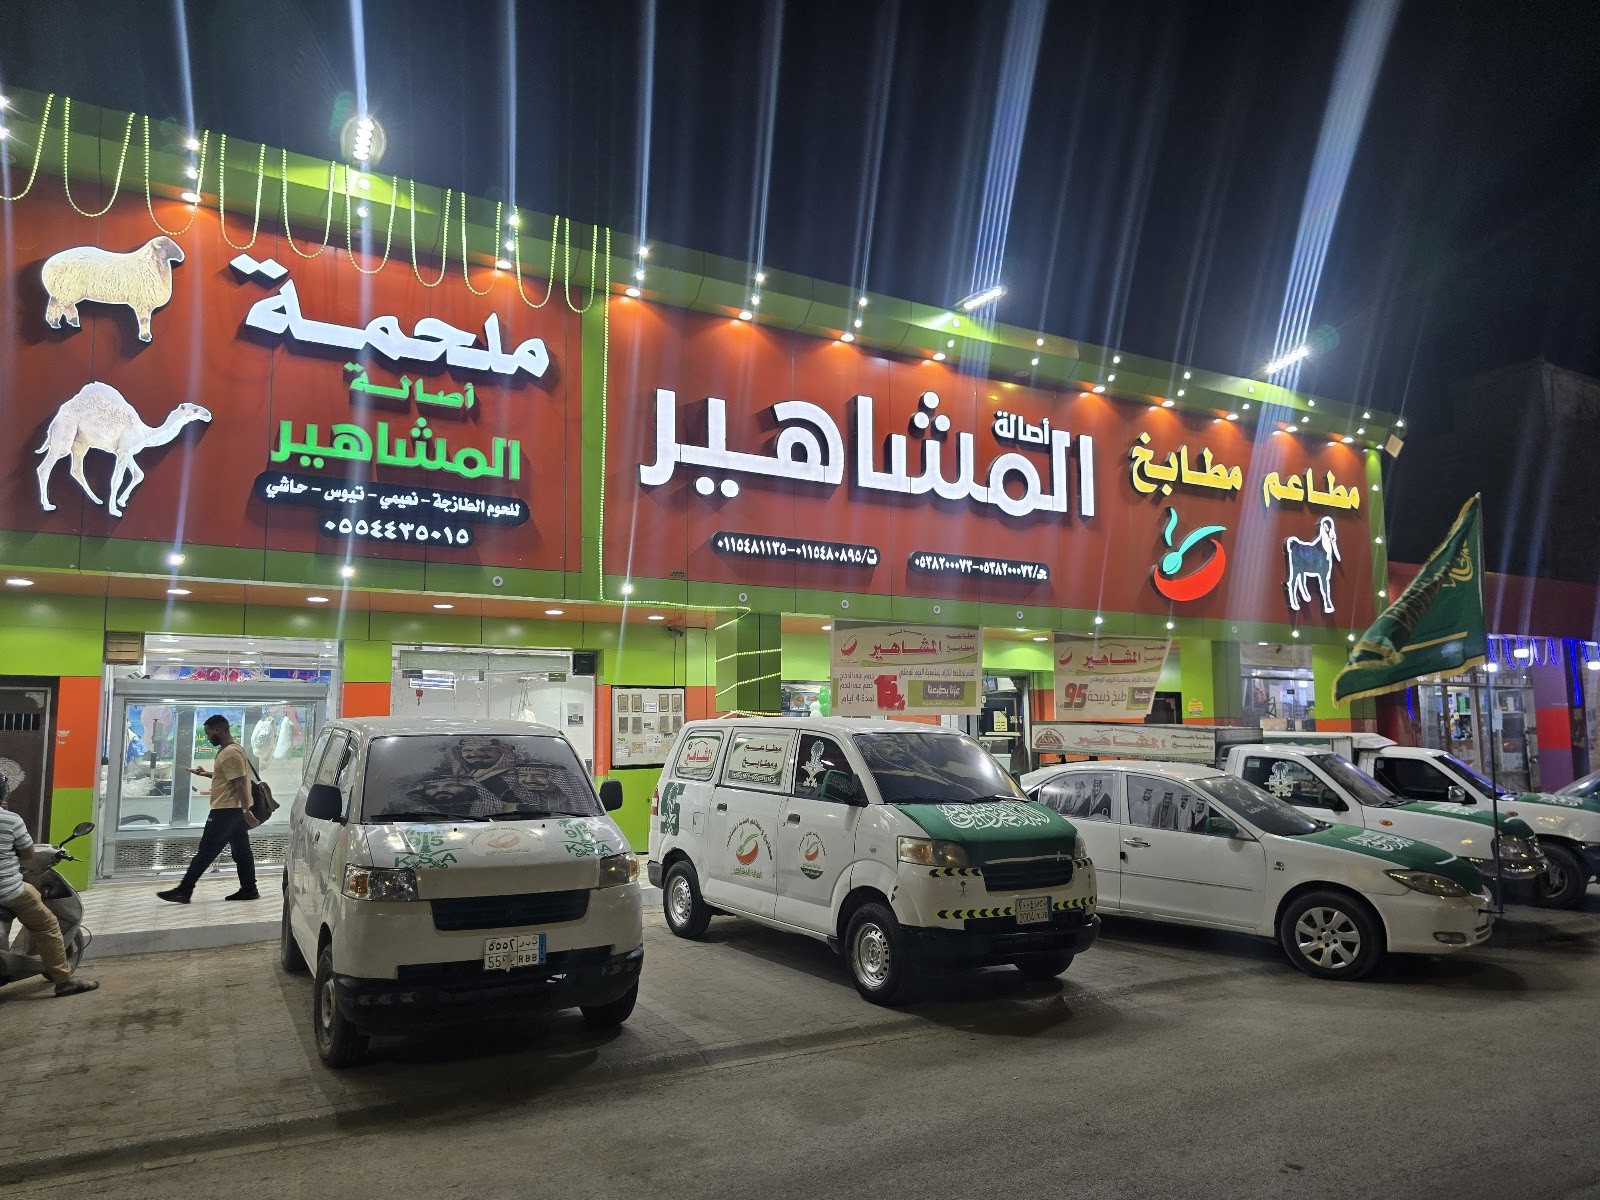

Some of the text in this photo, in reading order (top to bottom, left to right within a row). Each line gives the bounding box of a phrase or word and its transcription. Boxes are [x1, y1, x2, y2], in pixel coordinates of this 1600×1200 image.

[229, 253, 551, 378] ملحمة
[344, 362, 476, 409] أصالة
[995, 409, 1051, 445] أصالة
[270, 417, 521, 481] المشاهير
[638, 387, 1095, 518] المشاهير
[1131, 431, 1361, 510] مطاعم مطابخ
[265, 476, 308, 499] حاشي
[323, 485, 365, 503] تيوس
[379, 490, 419, 509] نعيمي
[433, 492, 485, 513] الطازجة
[487, 502, 521, 518] للحوم
[324, 518, 470, 545] ٠٥٥٤٤٣٥٠١٥
[868, 637, 942, 661] المشاهير
[1082, 650, 1141, 669] المشاهير
[1064, 683, 1088, 711] 95
[1087, 689, 1127, 707] طبخ ذبيحة
[518, 953, 538, 964] RBB
